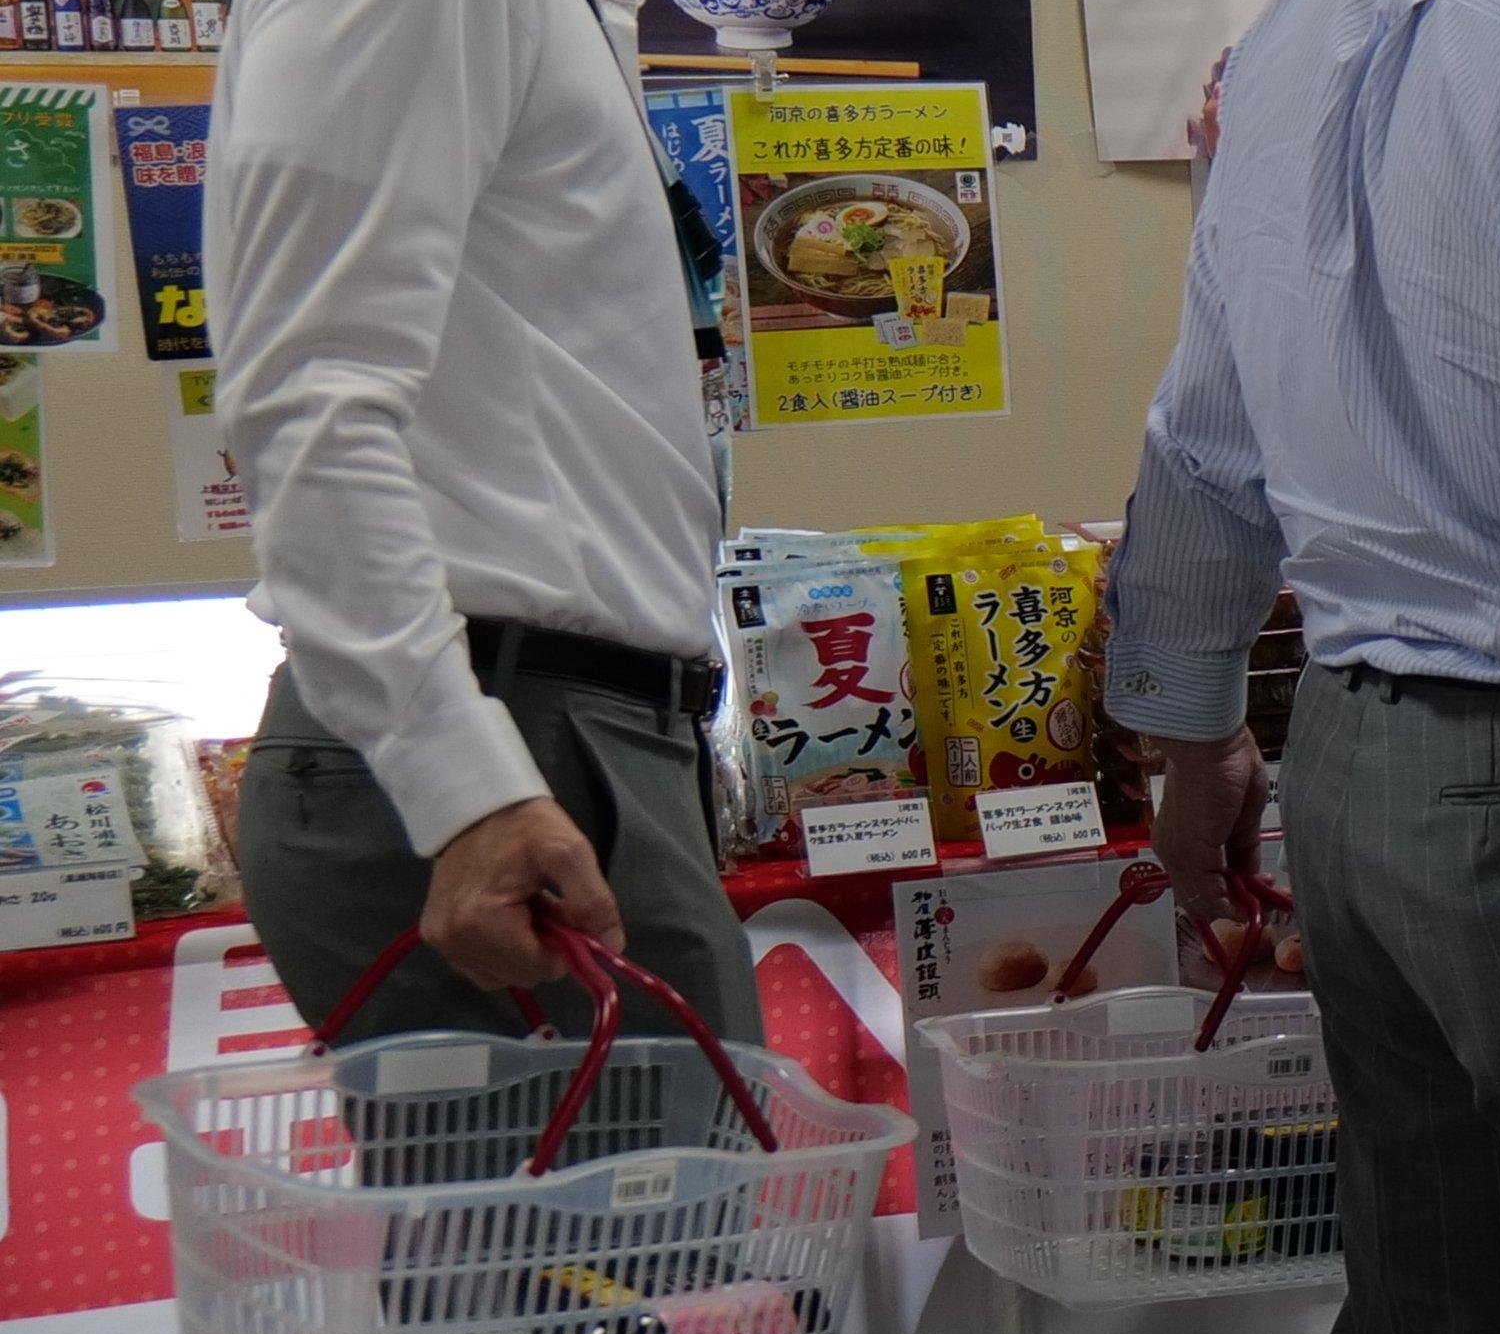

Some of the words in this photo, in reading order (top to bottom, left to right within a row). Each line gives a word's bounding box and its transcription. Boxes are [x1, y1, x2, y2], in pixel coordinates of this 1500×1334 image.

[752, 135, 968, 162] これが喜多方定番の味!
[769, 103, 948, 124] 河京の喜多方ラーメン
[801, 612, 896, 710] 夏
[975, 592, 1019, 728] ラーメン
[1009, 585, 1057, 707] 喜多方
